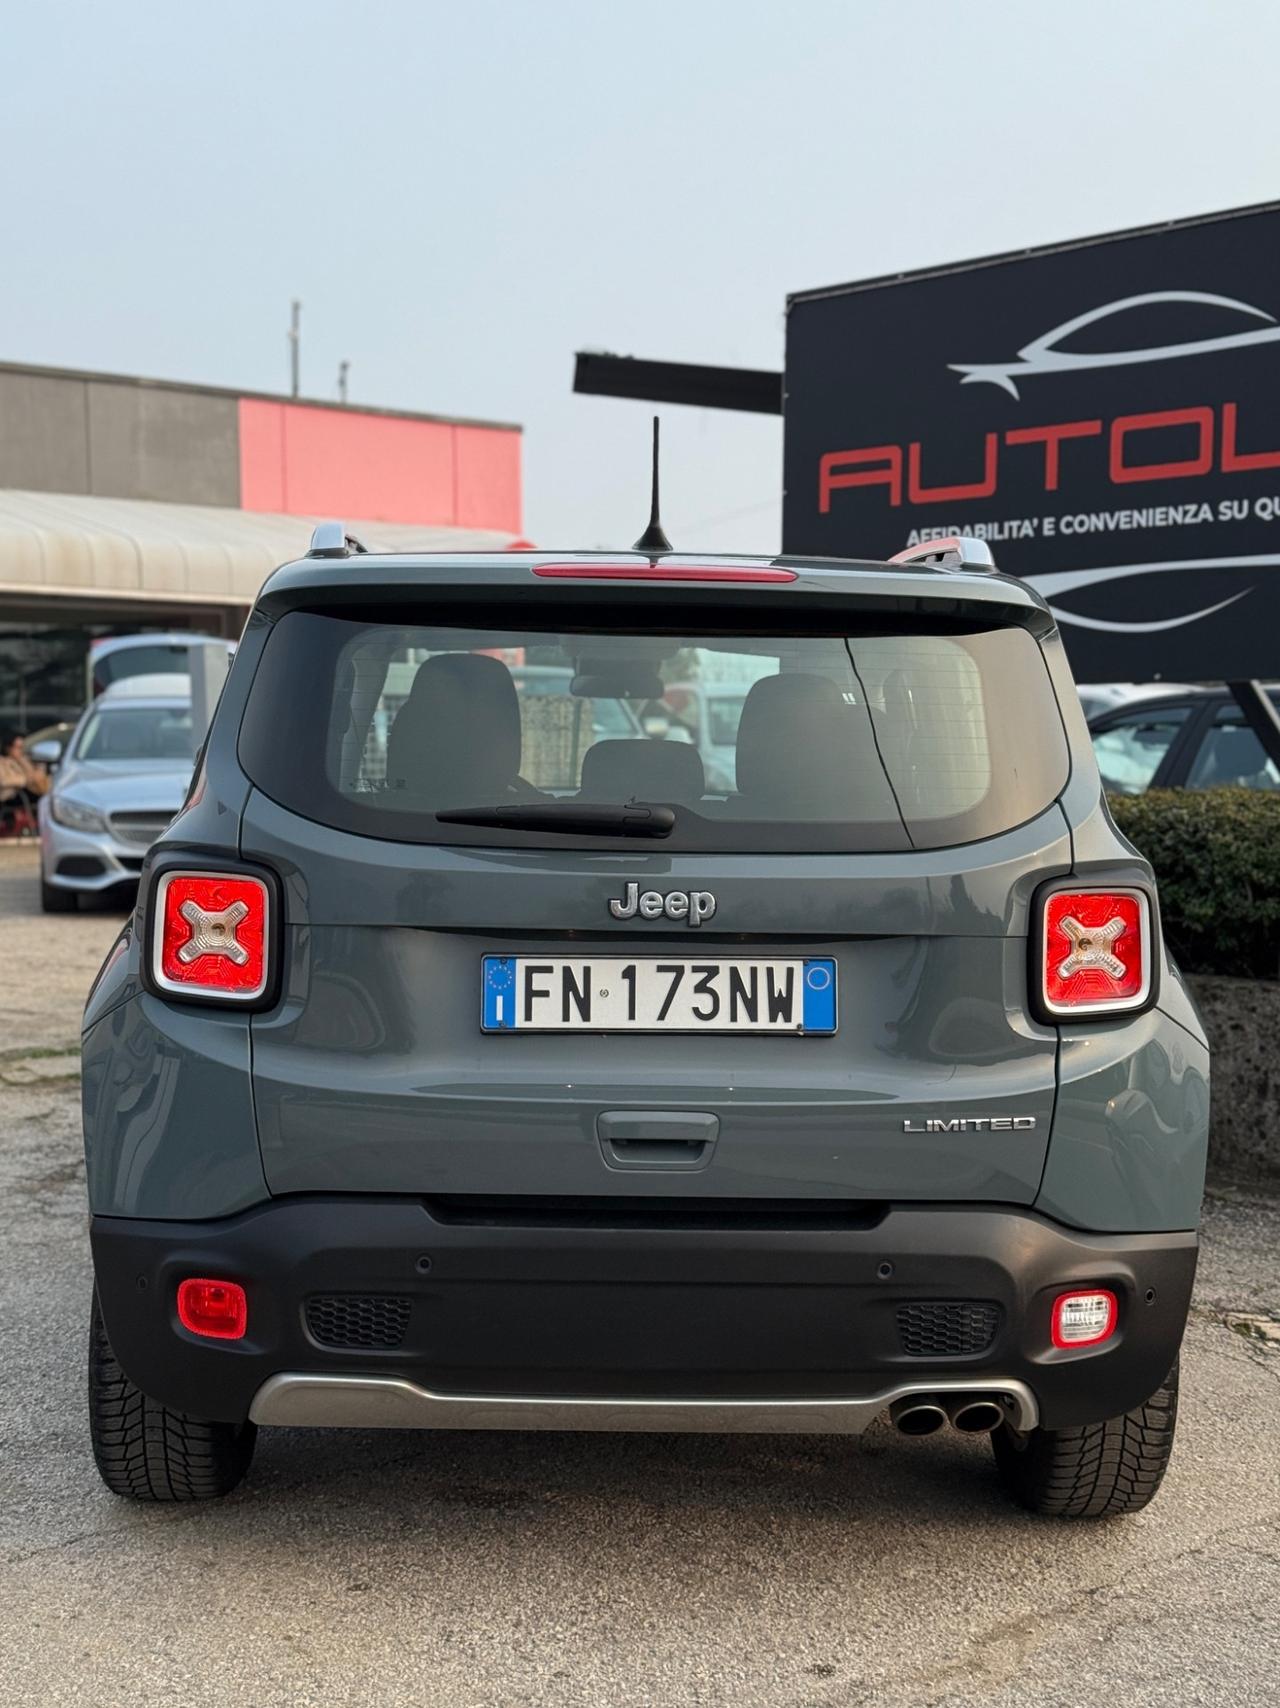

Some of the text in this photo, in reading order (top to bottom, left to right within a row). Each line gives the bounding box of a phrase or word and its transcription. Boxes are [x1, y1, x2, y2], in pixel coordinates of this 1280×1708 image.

[819, 402, 1280, 514] AUTOL
[1042, 516, 1056, 537] E
[1059, 502, 1214, 535] CONVENIENZA
[1218, 499, 1249, 521] SU
[609, 881, 717, 928] Jeep
[903, 1115, 1037, 1133] LIMITED
